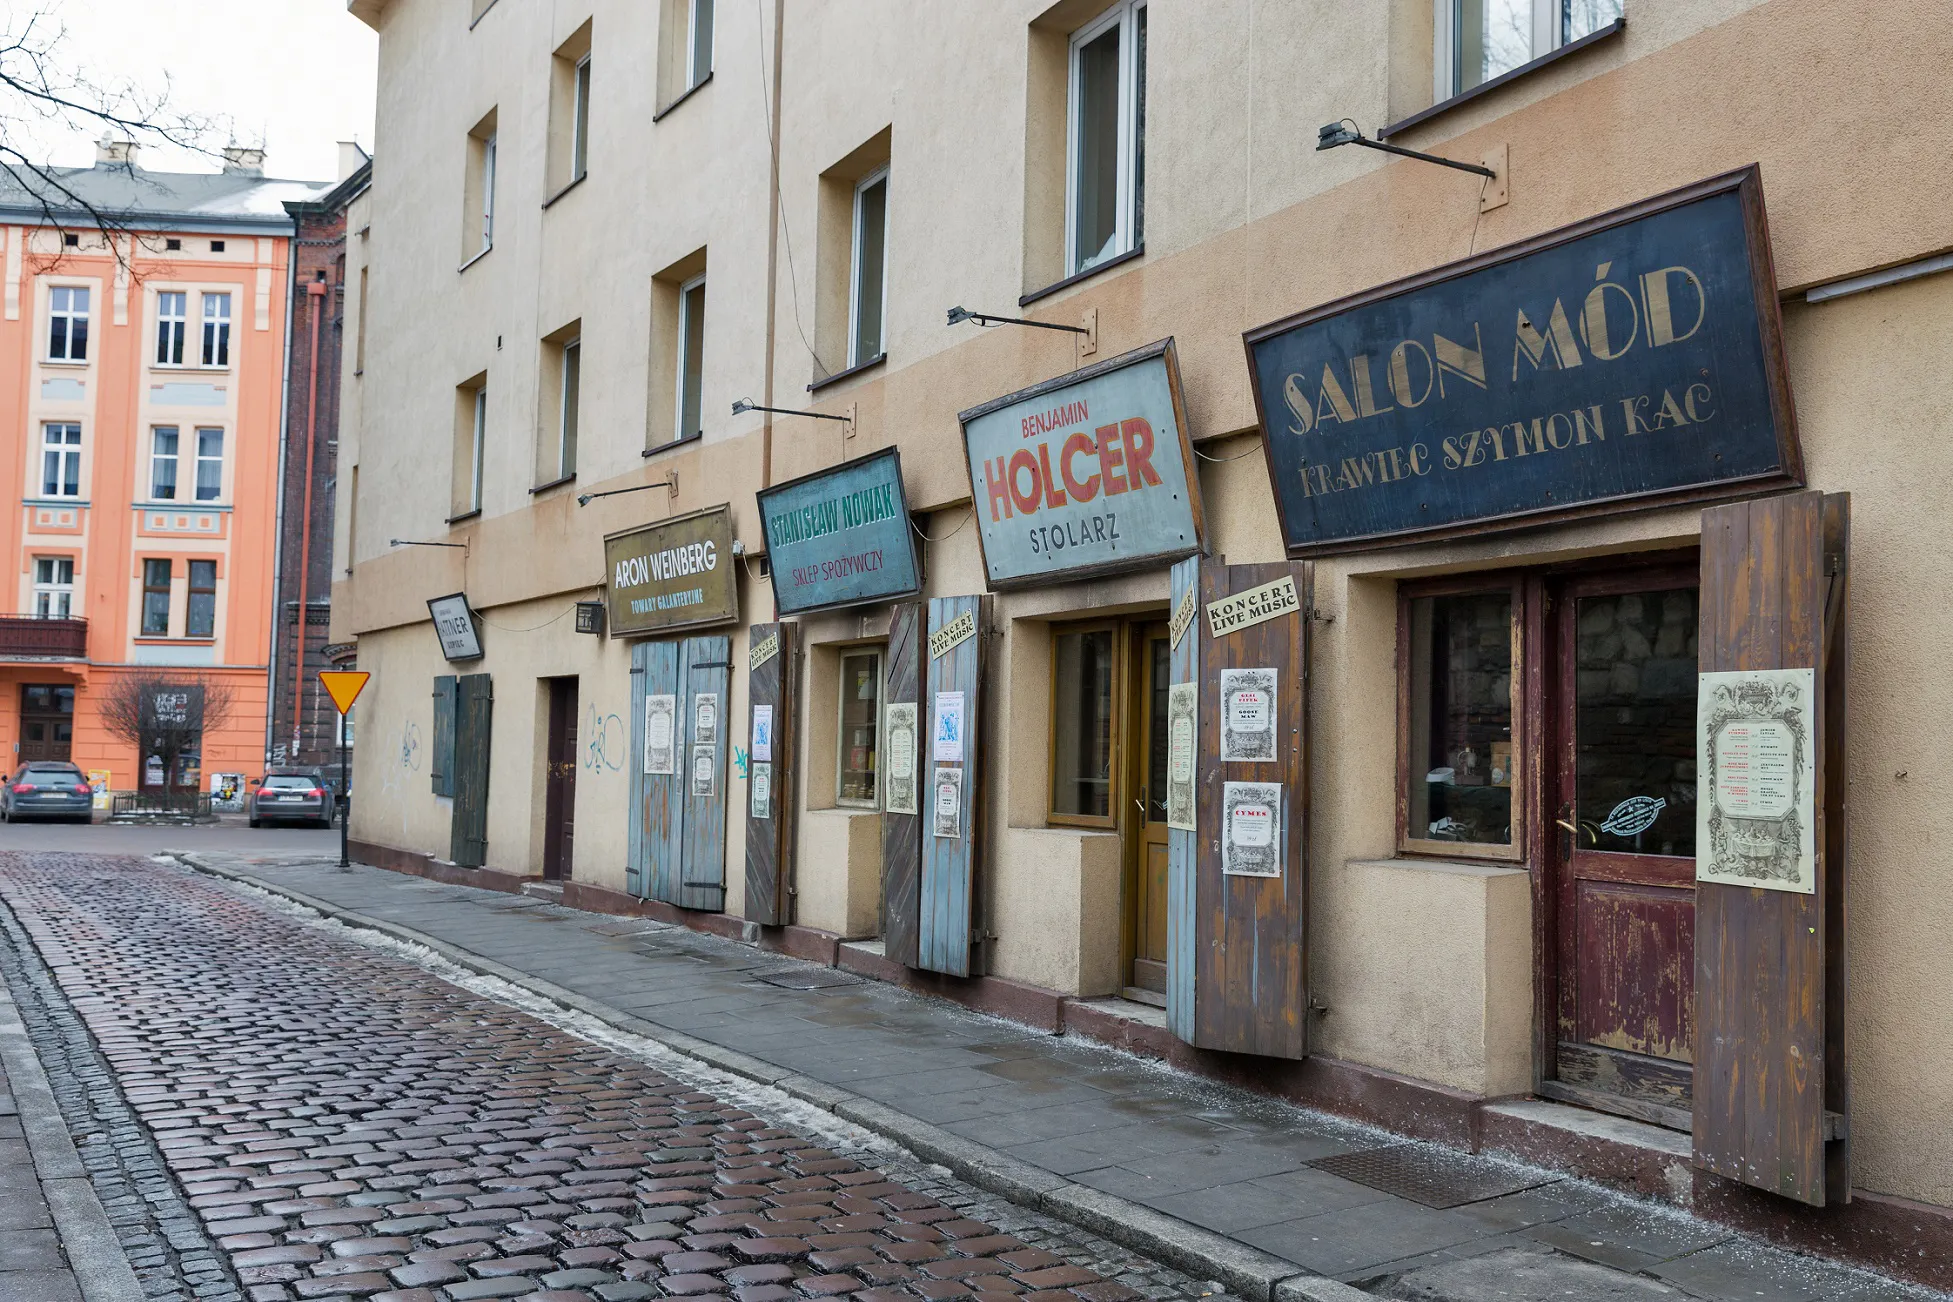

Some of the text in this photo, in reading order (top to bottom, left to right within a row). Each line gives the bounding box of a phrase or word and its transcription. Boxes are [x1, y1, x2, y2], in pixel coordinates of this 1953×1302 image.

[1283, 261, 1706, 436] SALON MÓD
[1021, 400, 1089, 439] BENJAMIN
[1299, 383, 1716, 498] KRAWIEC SZYMON KAC
[984, 416, 1163, 522] HOLCER
[771, 482, 897, 549] STANISŁAW NOWAK
[1030, 513, 1120, 554] STOLARZ
[615, 540, 717, 589] ARON WEINBERG
[792, 549, 884, 587] SKLEP SPOŻYWCZY
[631, 588, 704, 614] TOWARY GALANTERYJNE
[1209, 583, 1292, 620] KONCERT
[931, 614, 971, 647] KONCERT
[932, 623, 974, 655] LIVE MUSIC
